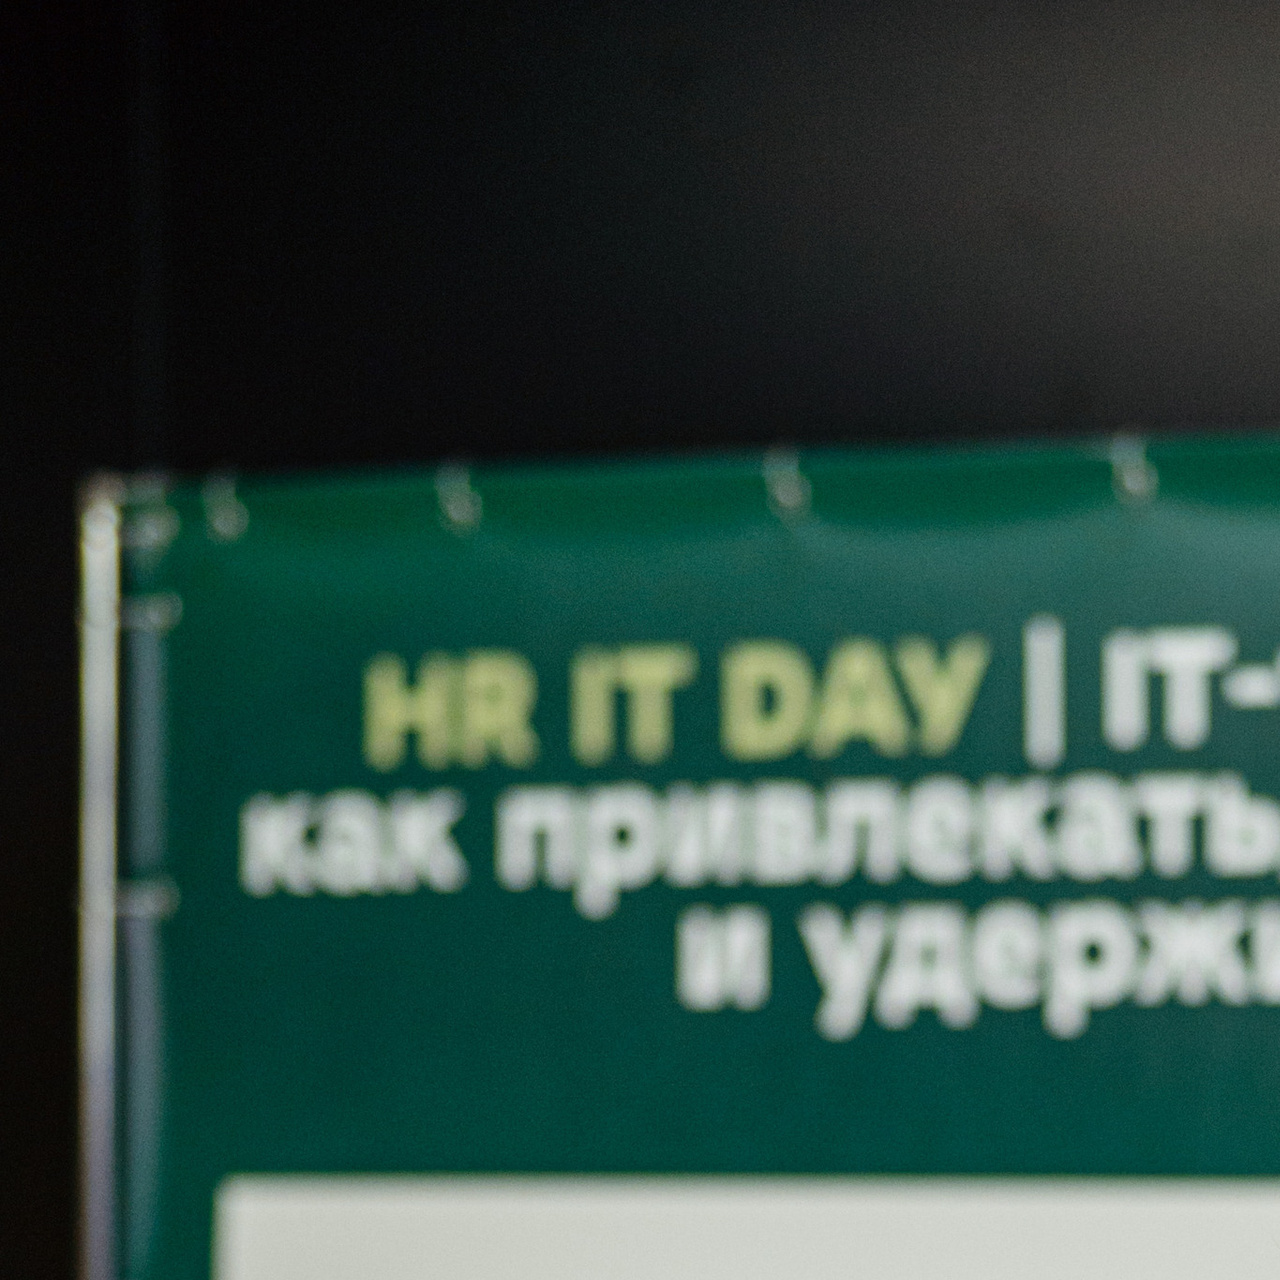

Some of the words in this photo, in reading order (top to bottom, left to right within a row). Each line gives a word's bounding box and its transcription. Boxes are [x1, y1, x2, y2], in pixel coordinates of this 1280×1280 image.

[364, 650, 537, 768] HR
[570, 642, 697, 764] IT
[720, 633, 990, 760] DAY
[239, 789, 465, 896] как
[675, 904, 771, 1011] и
